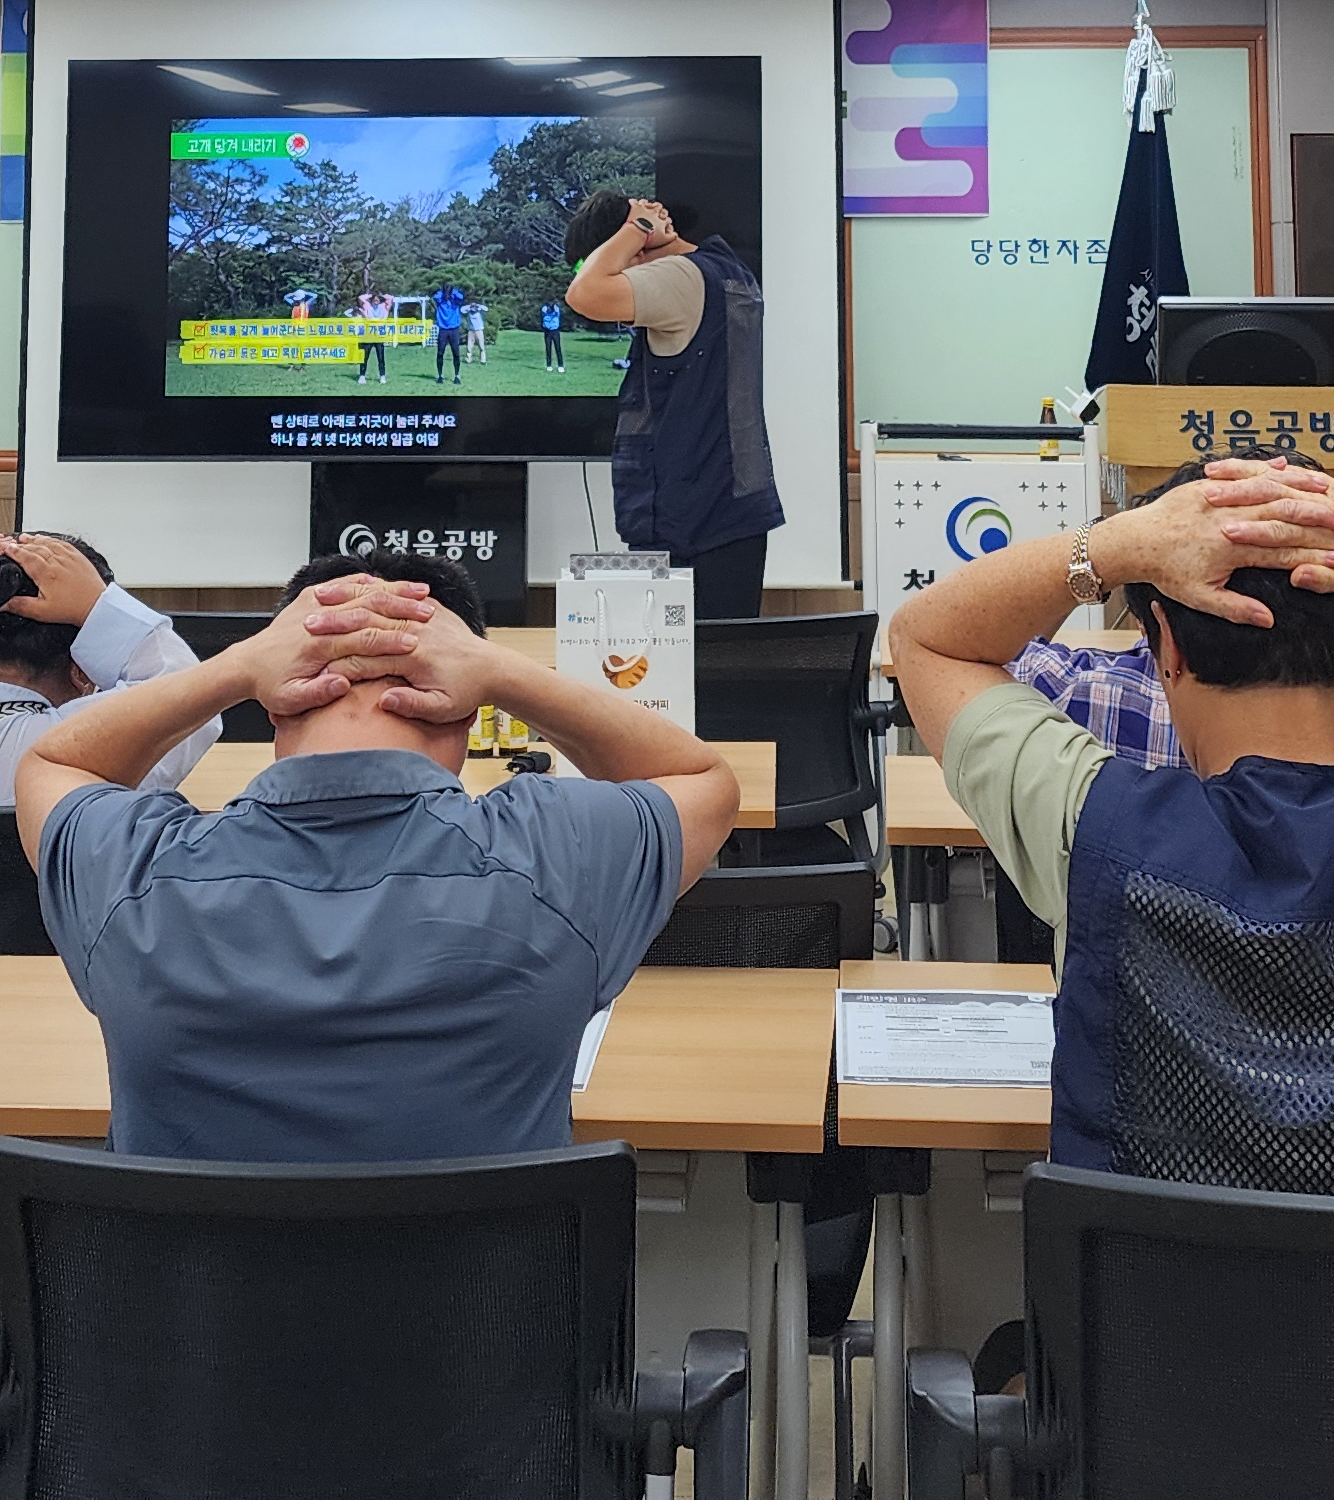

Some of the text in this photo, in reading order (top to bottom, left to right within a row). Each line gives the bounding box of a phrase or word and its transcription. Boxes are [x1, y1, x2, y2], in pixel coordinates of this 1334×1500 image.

[188, 138, 276, 154] 고개 당겨 내리기
[285, 414, 319, 428] 상태로
[322, 414, 357, 428] 아래로
[359, 414, 393, 428] 지긋이
[421, 414, 457, 428] 주세요
[270, 432, 439, 446] 하나 둘 셋 넷 다섯 여섯 일곱 여덟
[383, 529, 498, 561] 청음공방
